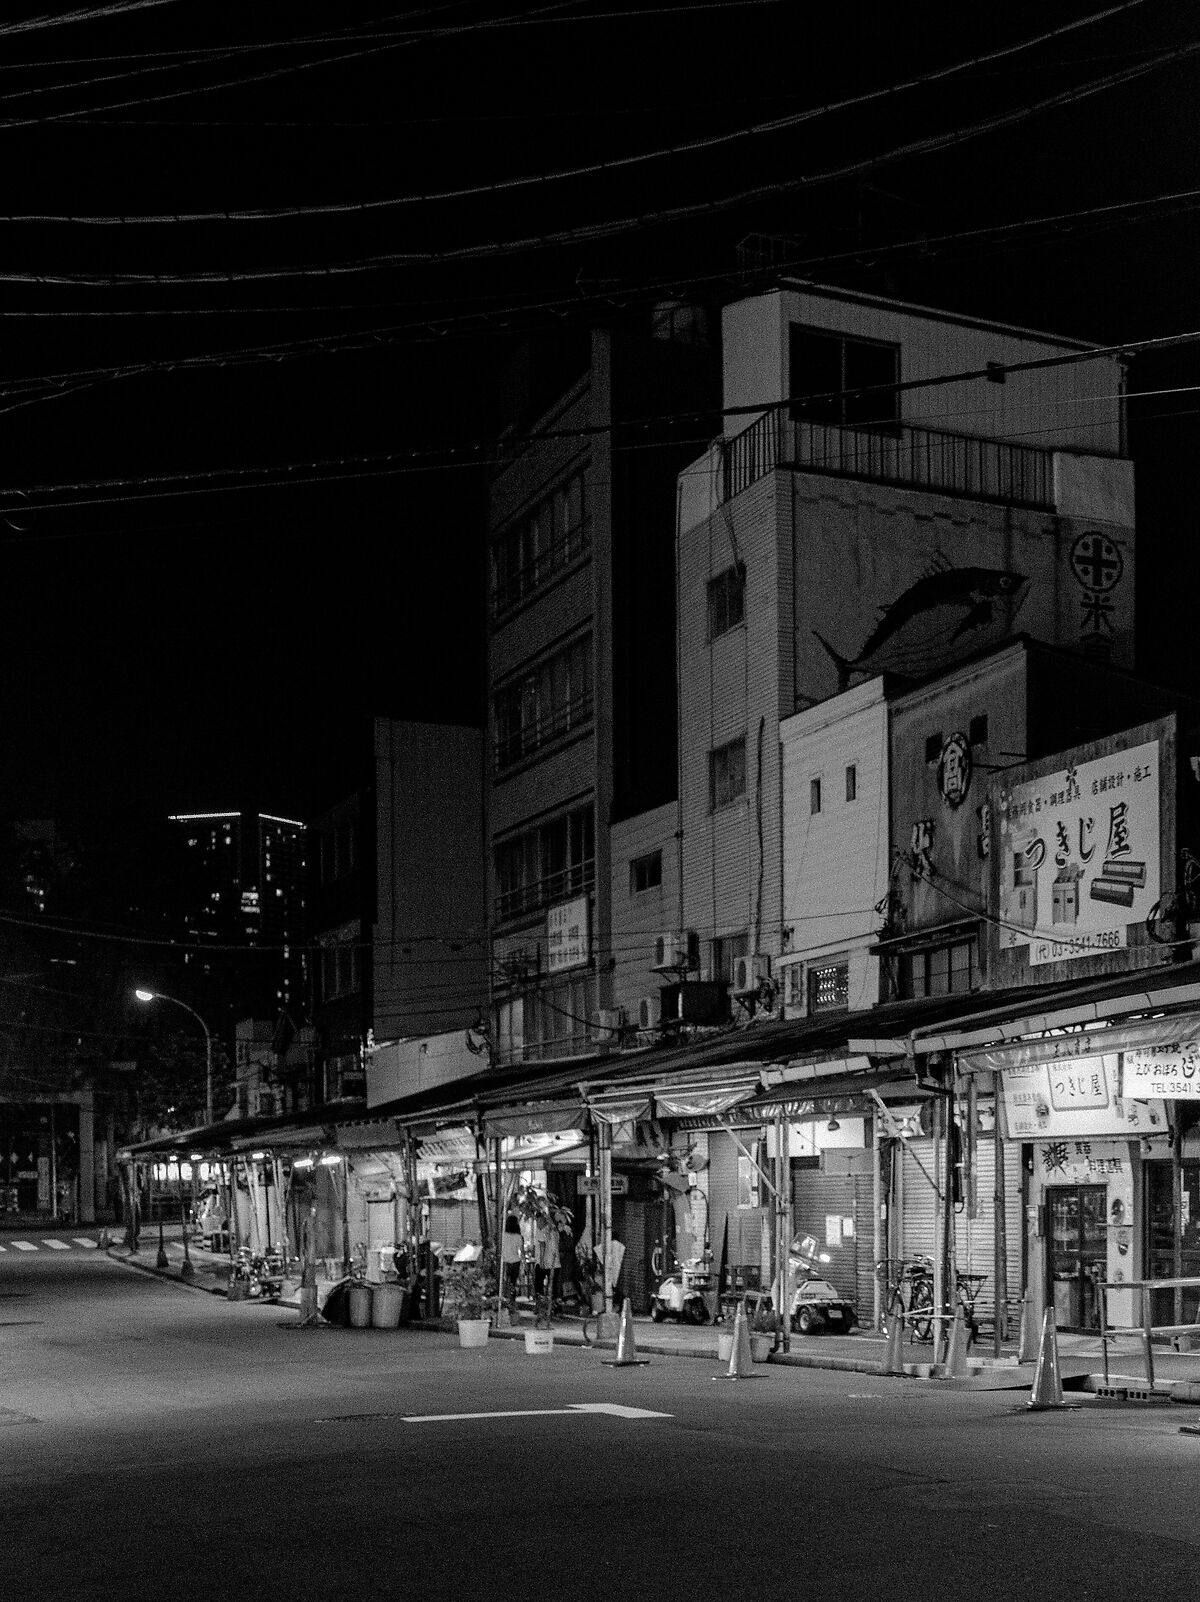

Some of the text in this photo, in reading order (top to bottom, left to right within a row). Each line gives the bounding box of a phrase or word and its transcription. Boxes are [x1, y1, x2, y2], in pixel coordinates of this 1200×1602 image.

[1025, 801, 1131, 871] つきじ屋
[1136, 1063, 1178, 1076] えびおぼろ
[1054, 1073, 1102, 1097] つきじ屋
[1151, 1082, 1167, 1093] TEL
[1170, 1082, 1192, 1093] 3541
